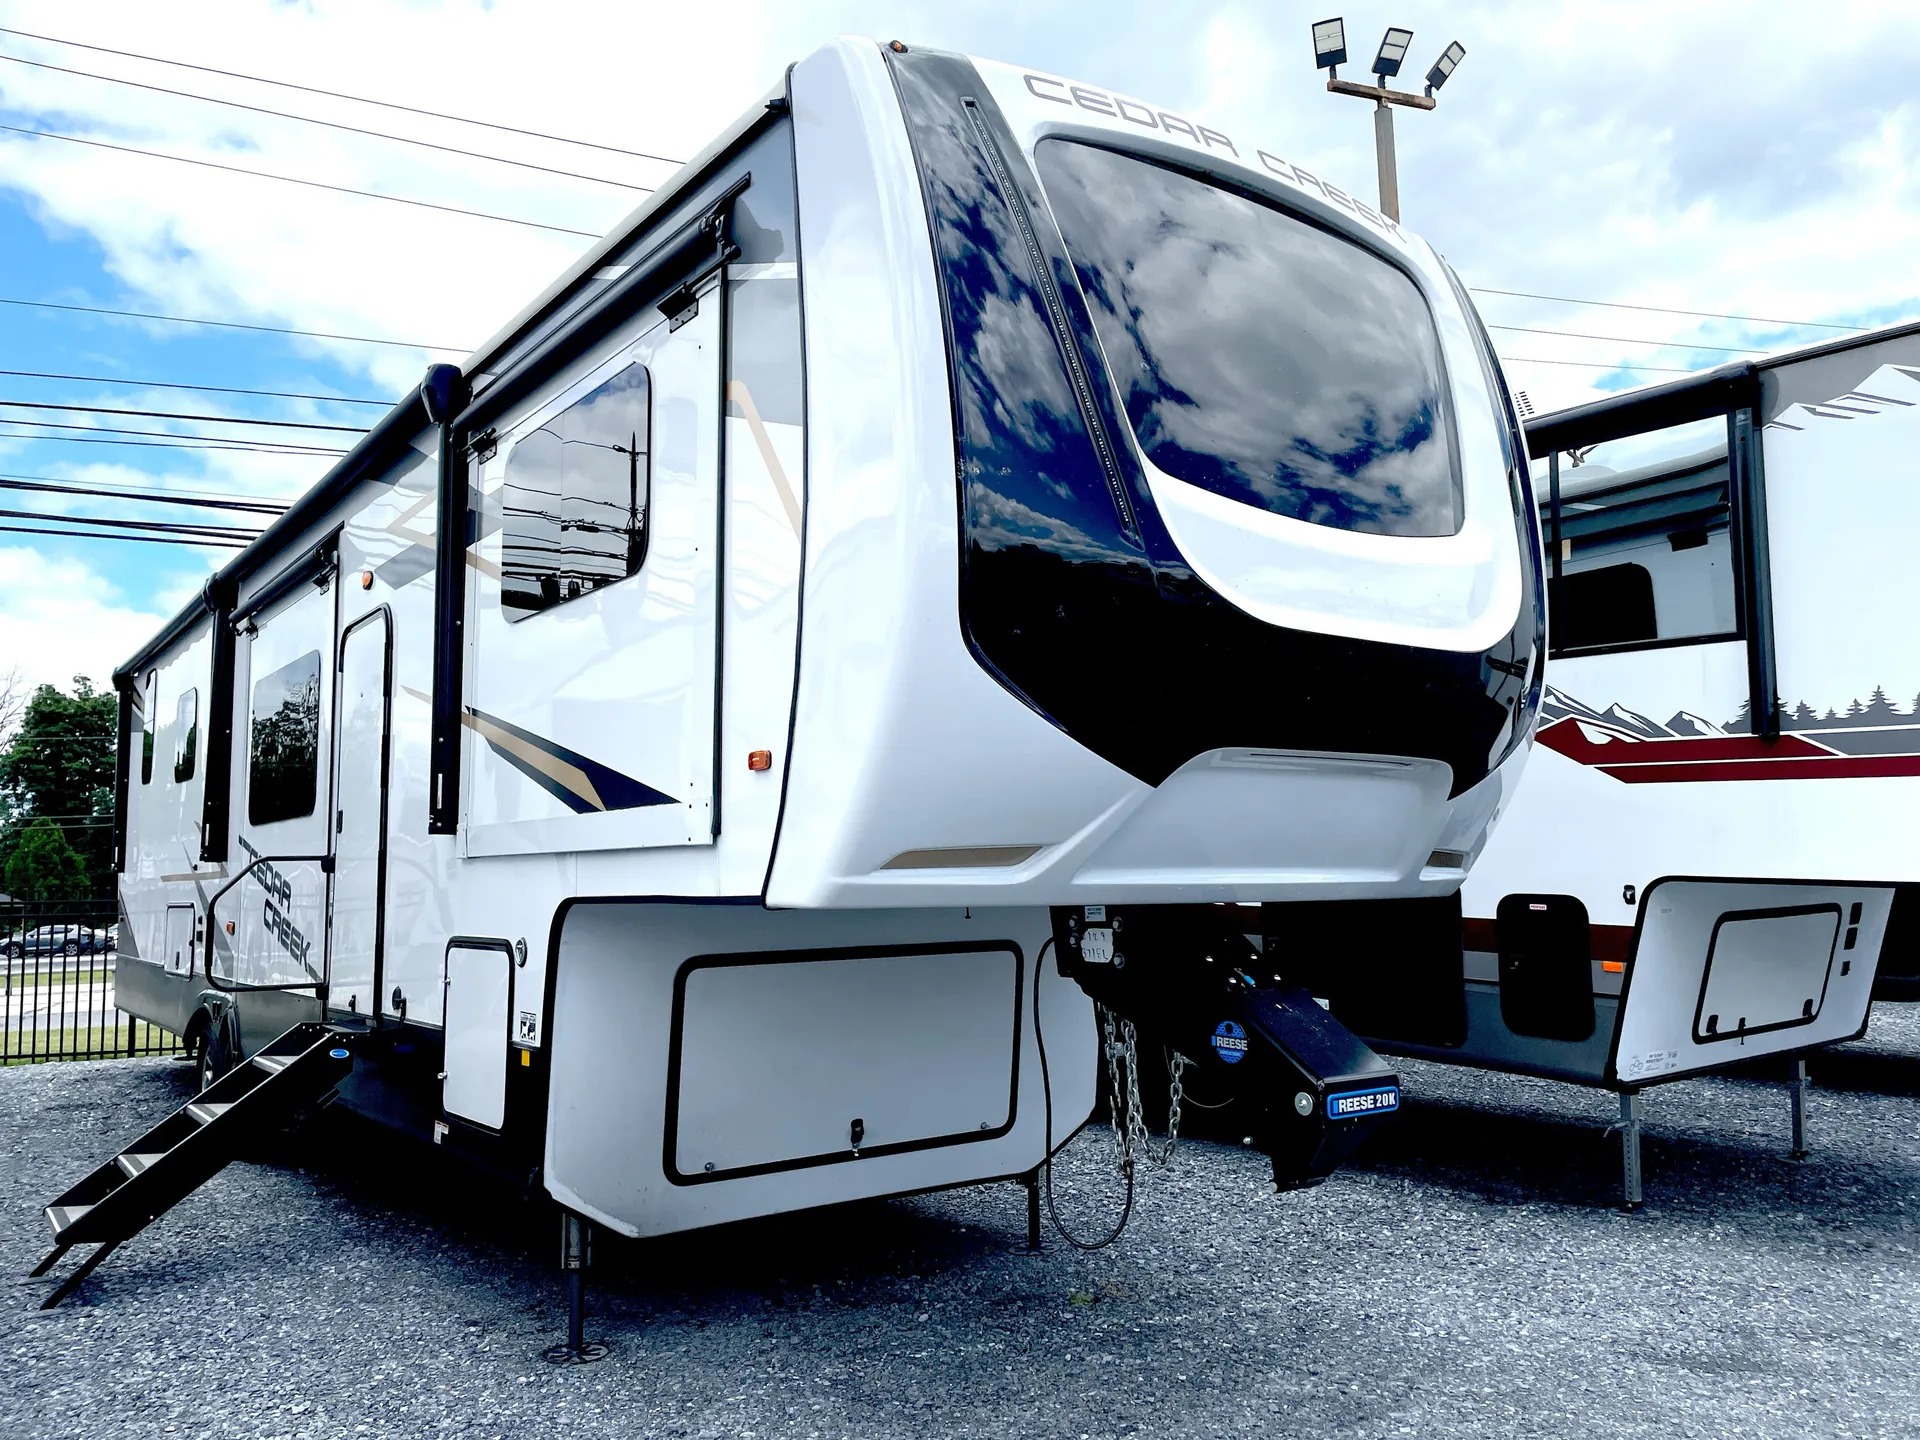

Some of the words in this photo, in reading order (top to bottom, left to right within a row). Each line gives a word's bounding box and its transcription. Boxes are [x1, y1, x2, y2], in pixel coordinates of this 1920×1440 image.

[1022, 73, 1241, 159] CEDAR
[1256, 149, 1408, 244] CREEK
[249, 847, 292, 914] CEDAR
[263, 898, 311, 972] CREEK
[1216, 1036, 1248, 1051] REESE
[1338, 1095, 1375, 1113] REESE
[1375, 1092, 1396, 1107] 20K
